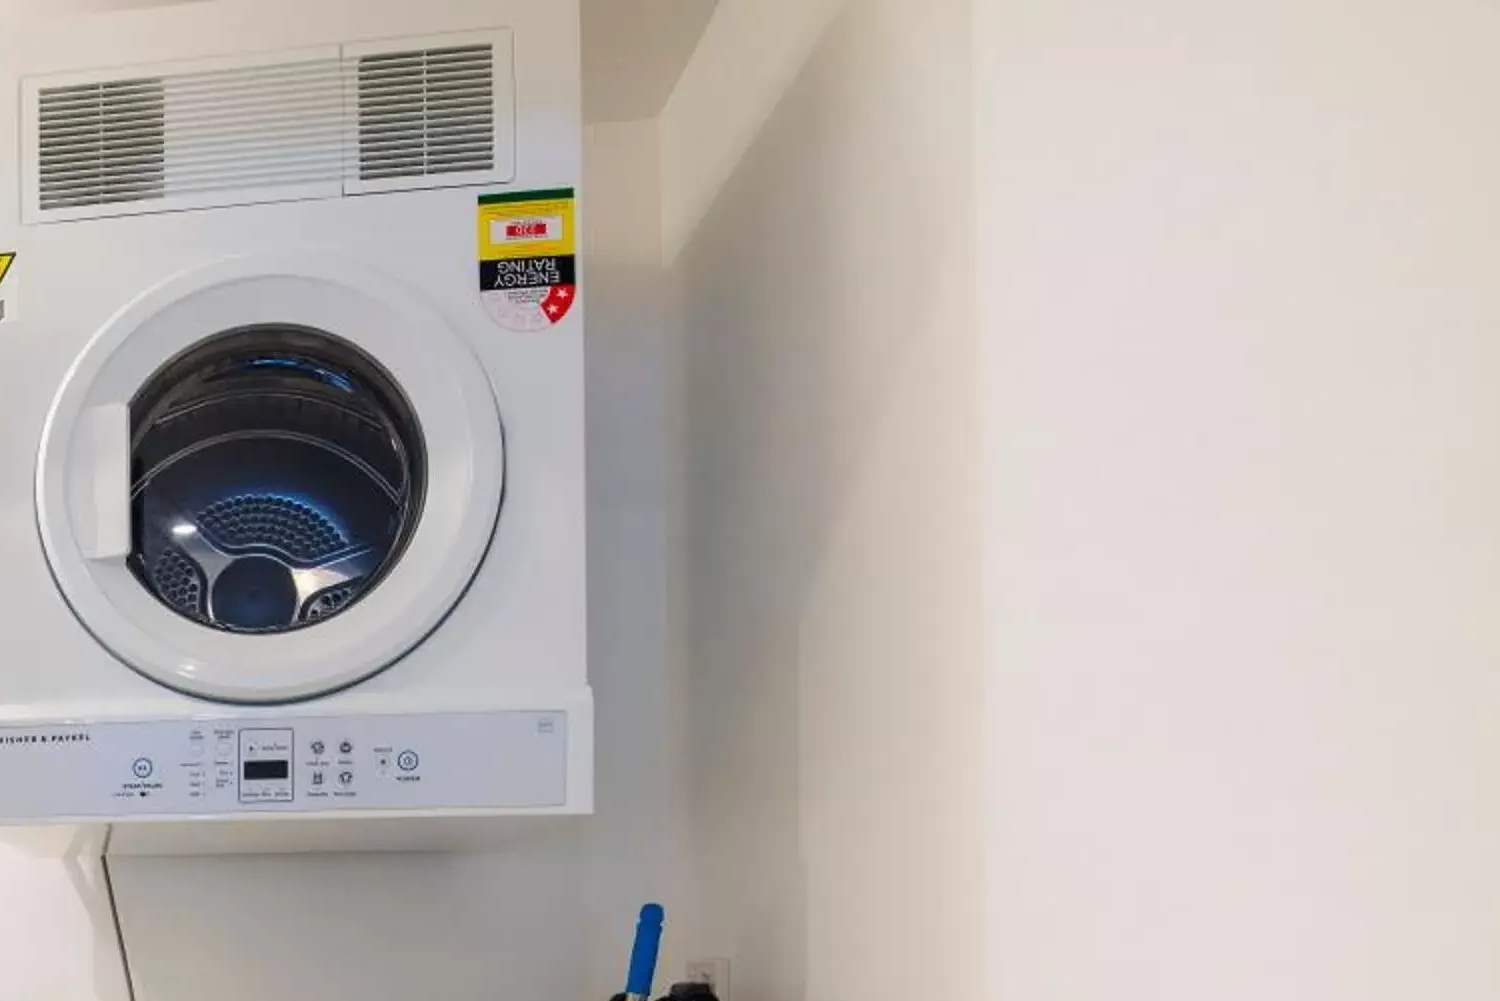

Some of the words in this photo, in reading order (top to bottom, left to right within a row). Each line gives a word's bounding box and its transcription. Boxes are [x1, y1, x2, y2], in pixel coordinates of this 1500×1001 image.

[497, 258, 556, 274] RATING
[493, 270, 560, 288] ENERGY
[0, 735, 37, 744] FISHER
[51, 733, 91, 742] PAYKEL
